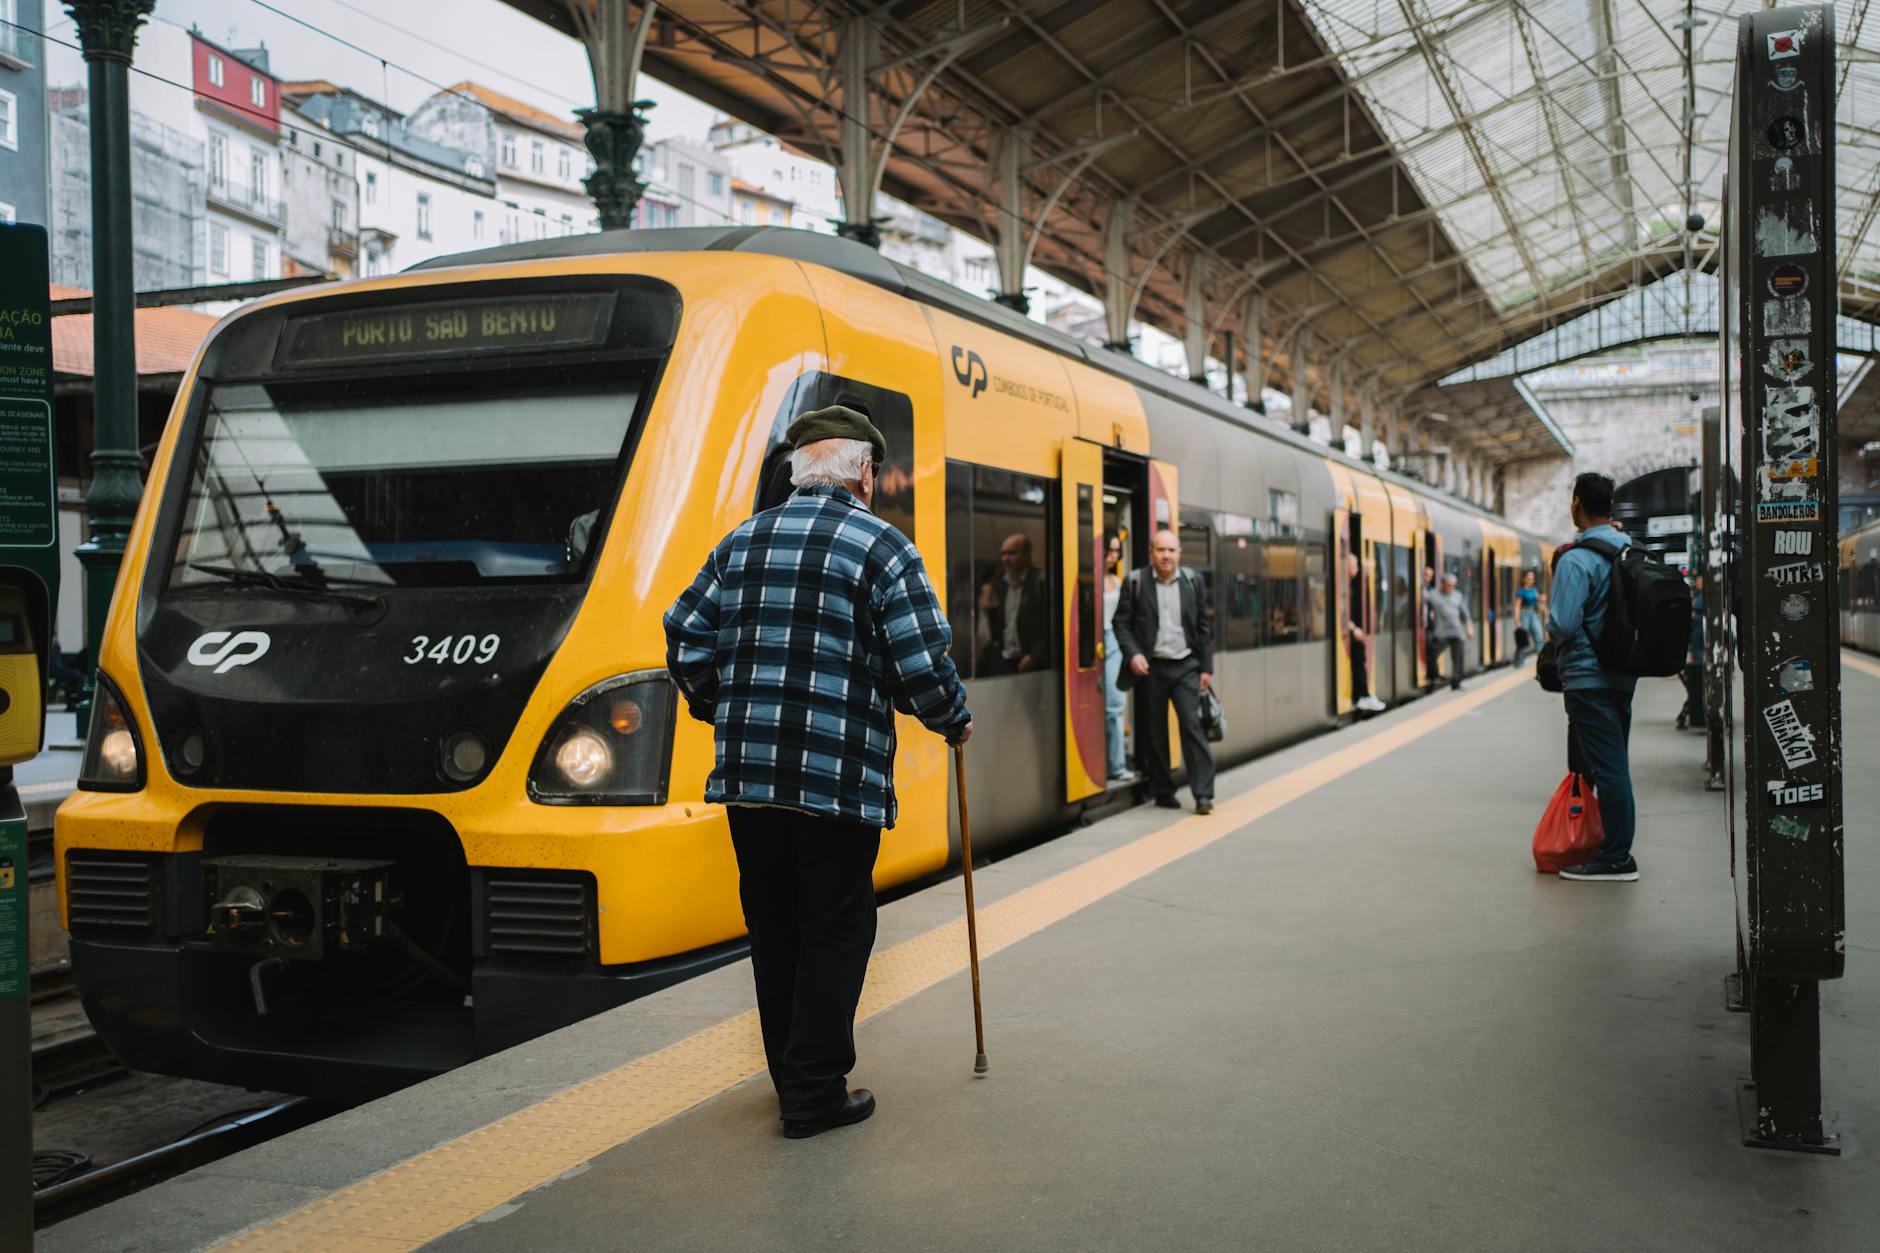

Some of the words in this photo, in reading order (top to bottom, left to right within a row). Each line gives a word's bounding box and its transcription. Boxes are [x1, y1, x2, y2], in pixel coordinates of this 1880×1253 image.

[343, 318, 412, 347] PORTO
[482, 304, 556, 337] BENTO
[24, 343, 45, 354] deve
[19, 366, 46, 378] ZONE
[21, 376, 39, 386] have
[1759, 502, 1817, 521] BANDOLEROS
[1774, 530, 1813, 555] ROW
[187, 631, 271, 674] CP
[403, 633, 500, 665] 3409
[1772, 783, 1823, 806] TOES
